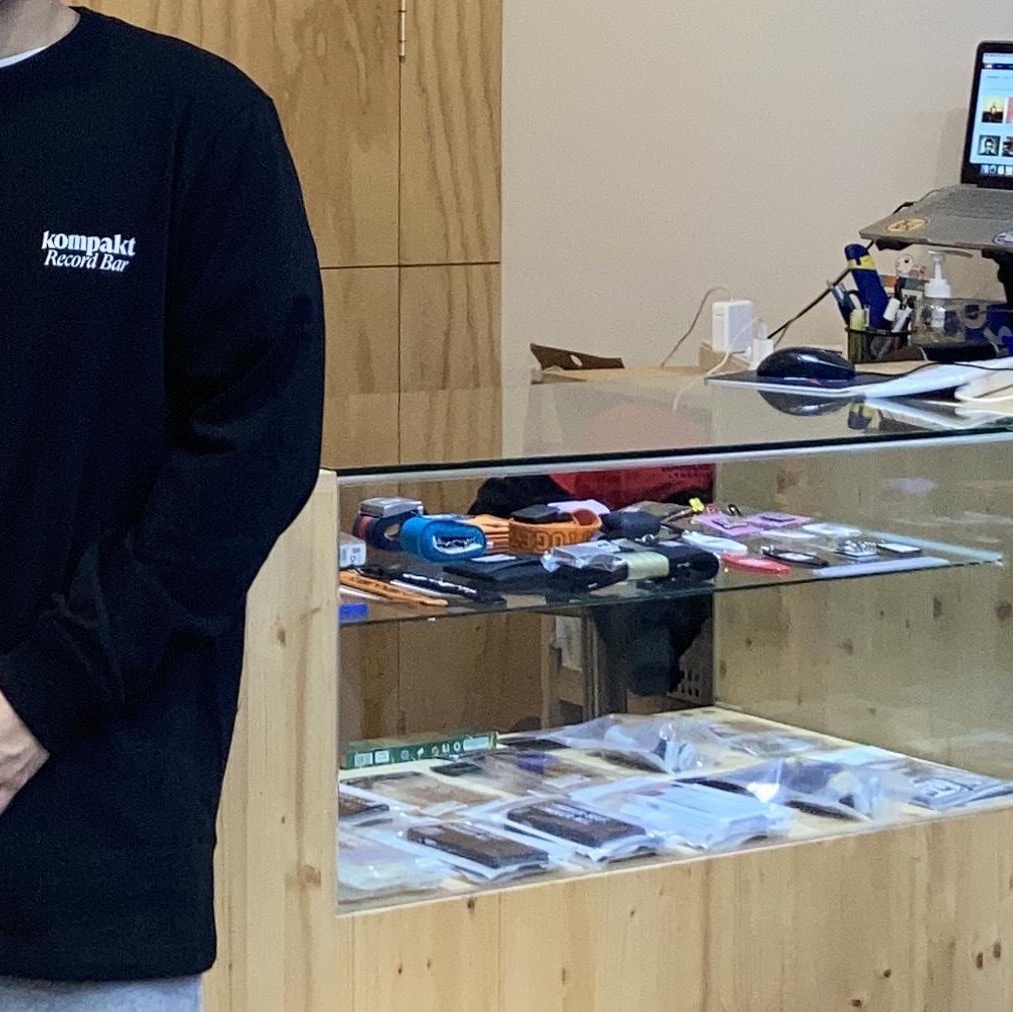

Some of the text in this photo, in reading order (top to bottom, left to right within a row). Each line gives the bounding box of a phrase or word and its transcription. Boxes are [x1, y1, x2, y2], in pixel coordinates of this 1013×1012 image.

[41, 230, 136, 256] kompakt
[44, 250, 129, 272] Record Bar
